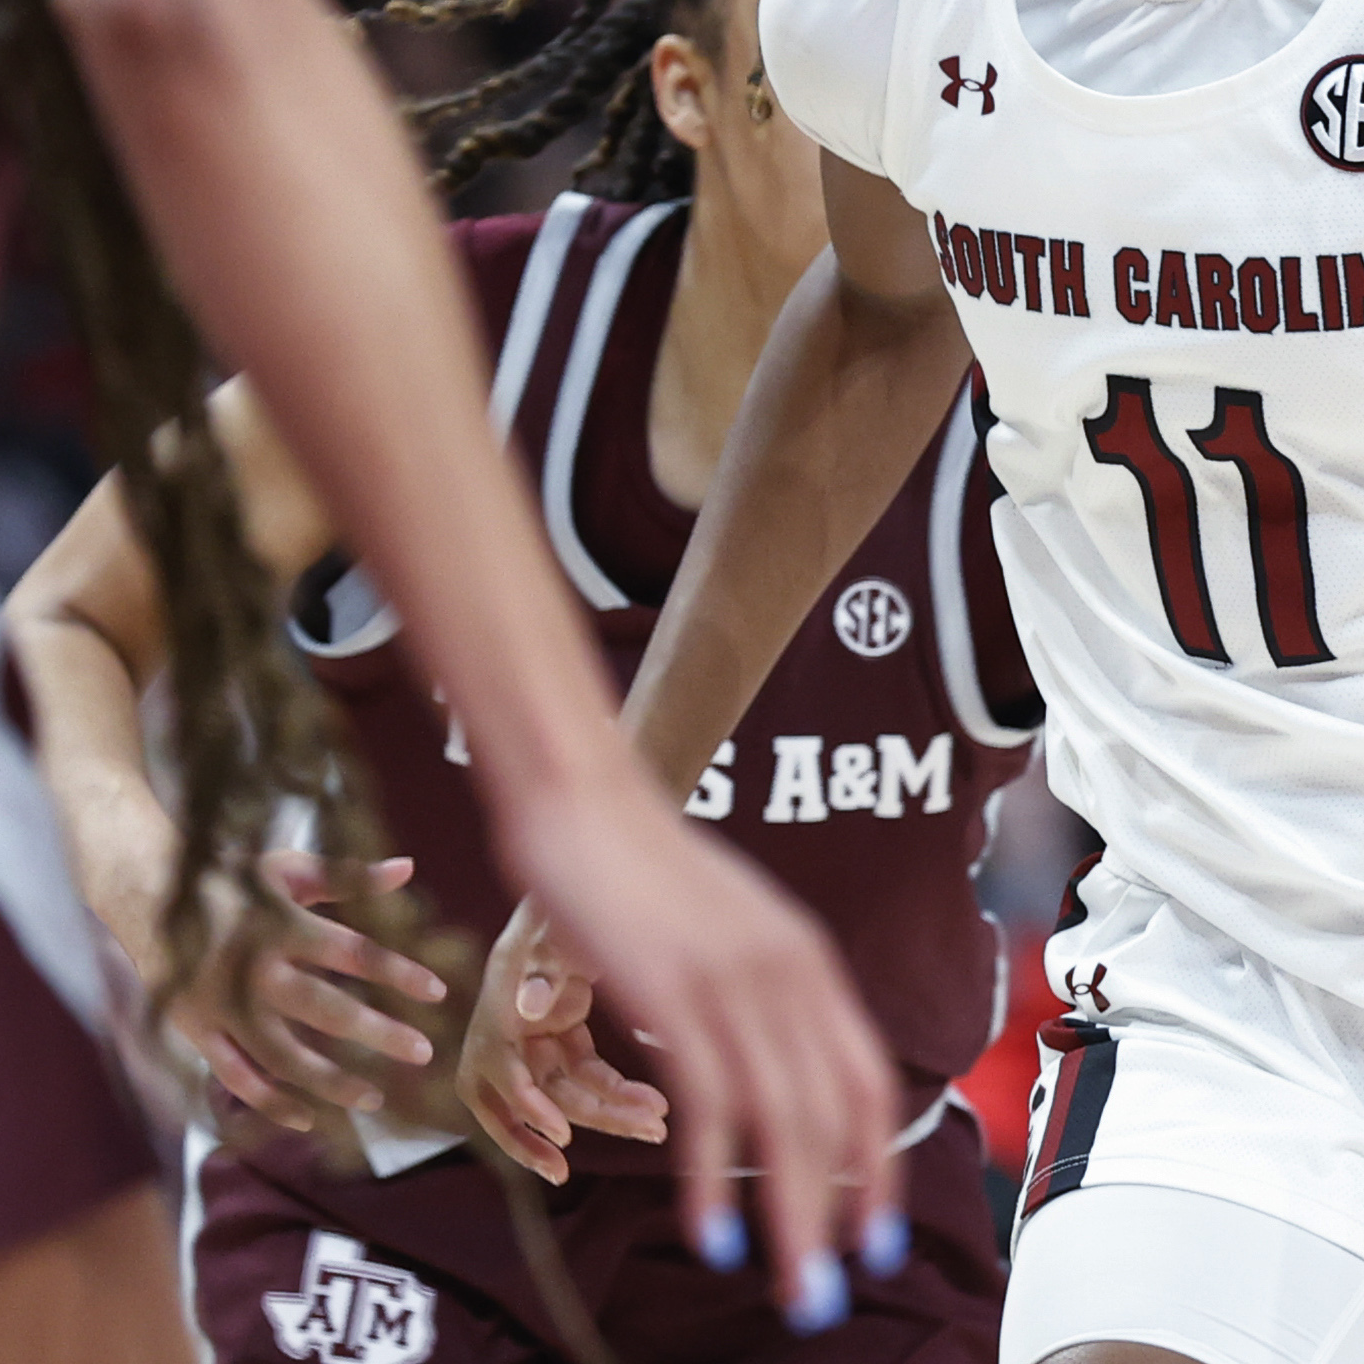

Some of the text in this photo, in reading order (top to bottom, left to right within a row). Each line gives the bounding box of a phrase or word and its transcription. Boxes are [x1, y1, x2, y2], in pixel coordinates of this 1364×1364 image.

[934, 210, 1091, 318] SOUTH
[1082, 373, 1337, 668] 11
[842, 587, 904, 650] SEC
[762, 732, 954, 824] A&M
